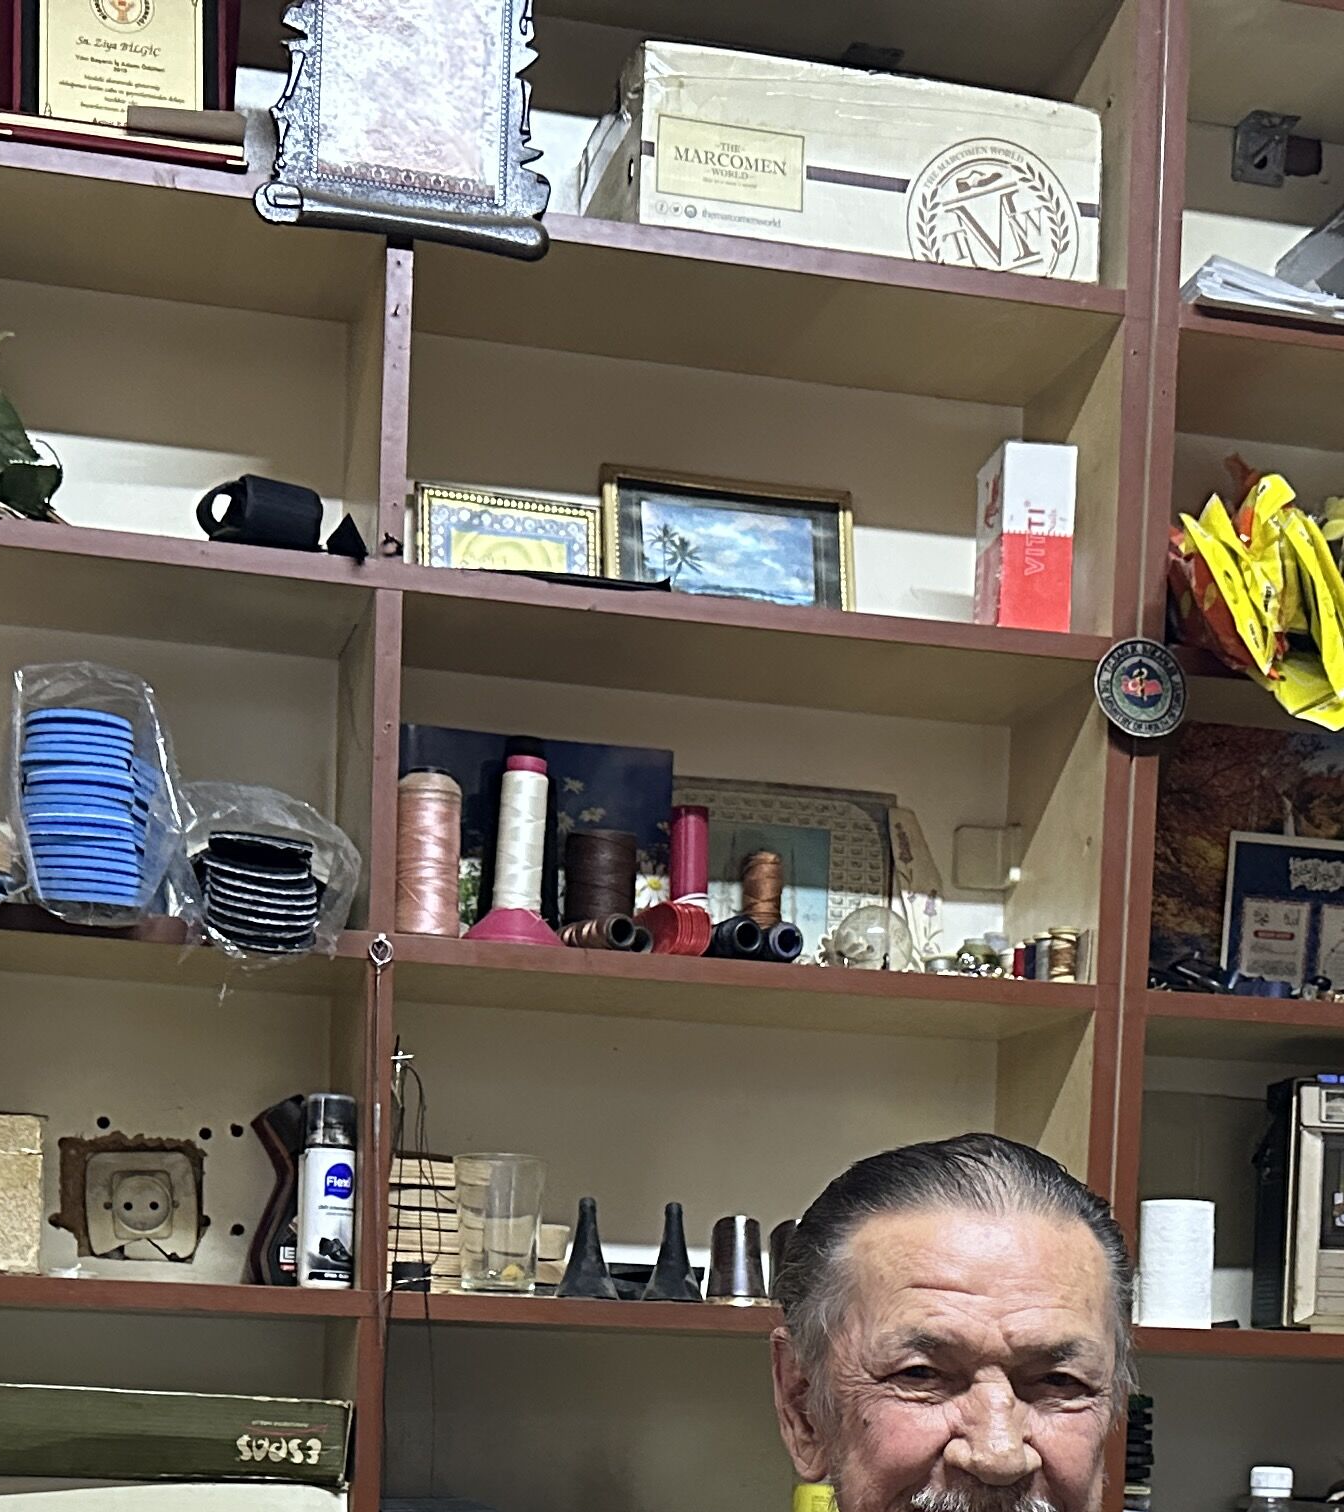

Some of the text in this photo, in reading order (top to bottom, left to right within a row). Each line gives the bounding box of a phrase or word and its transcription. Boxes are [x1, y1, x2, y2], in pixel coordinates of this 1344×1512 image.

[720, 143, 741, 153] THE
[990, 146, 1025, 164] WORLD
[674, 145, 787, 176] MARCOMEN
[712, 168, 749, 180] WORLD
